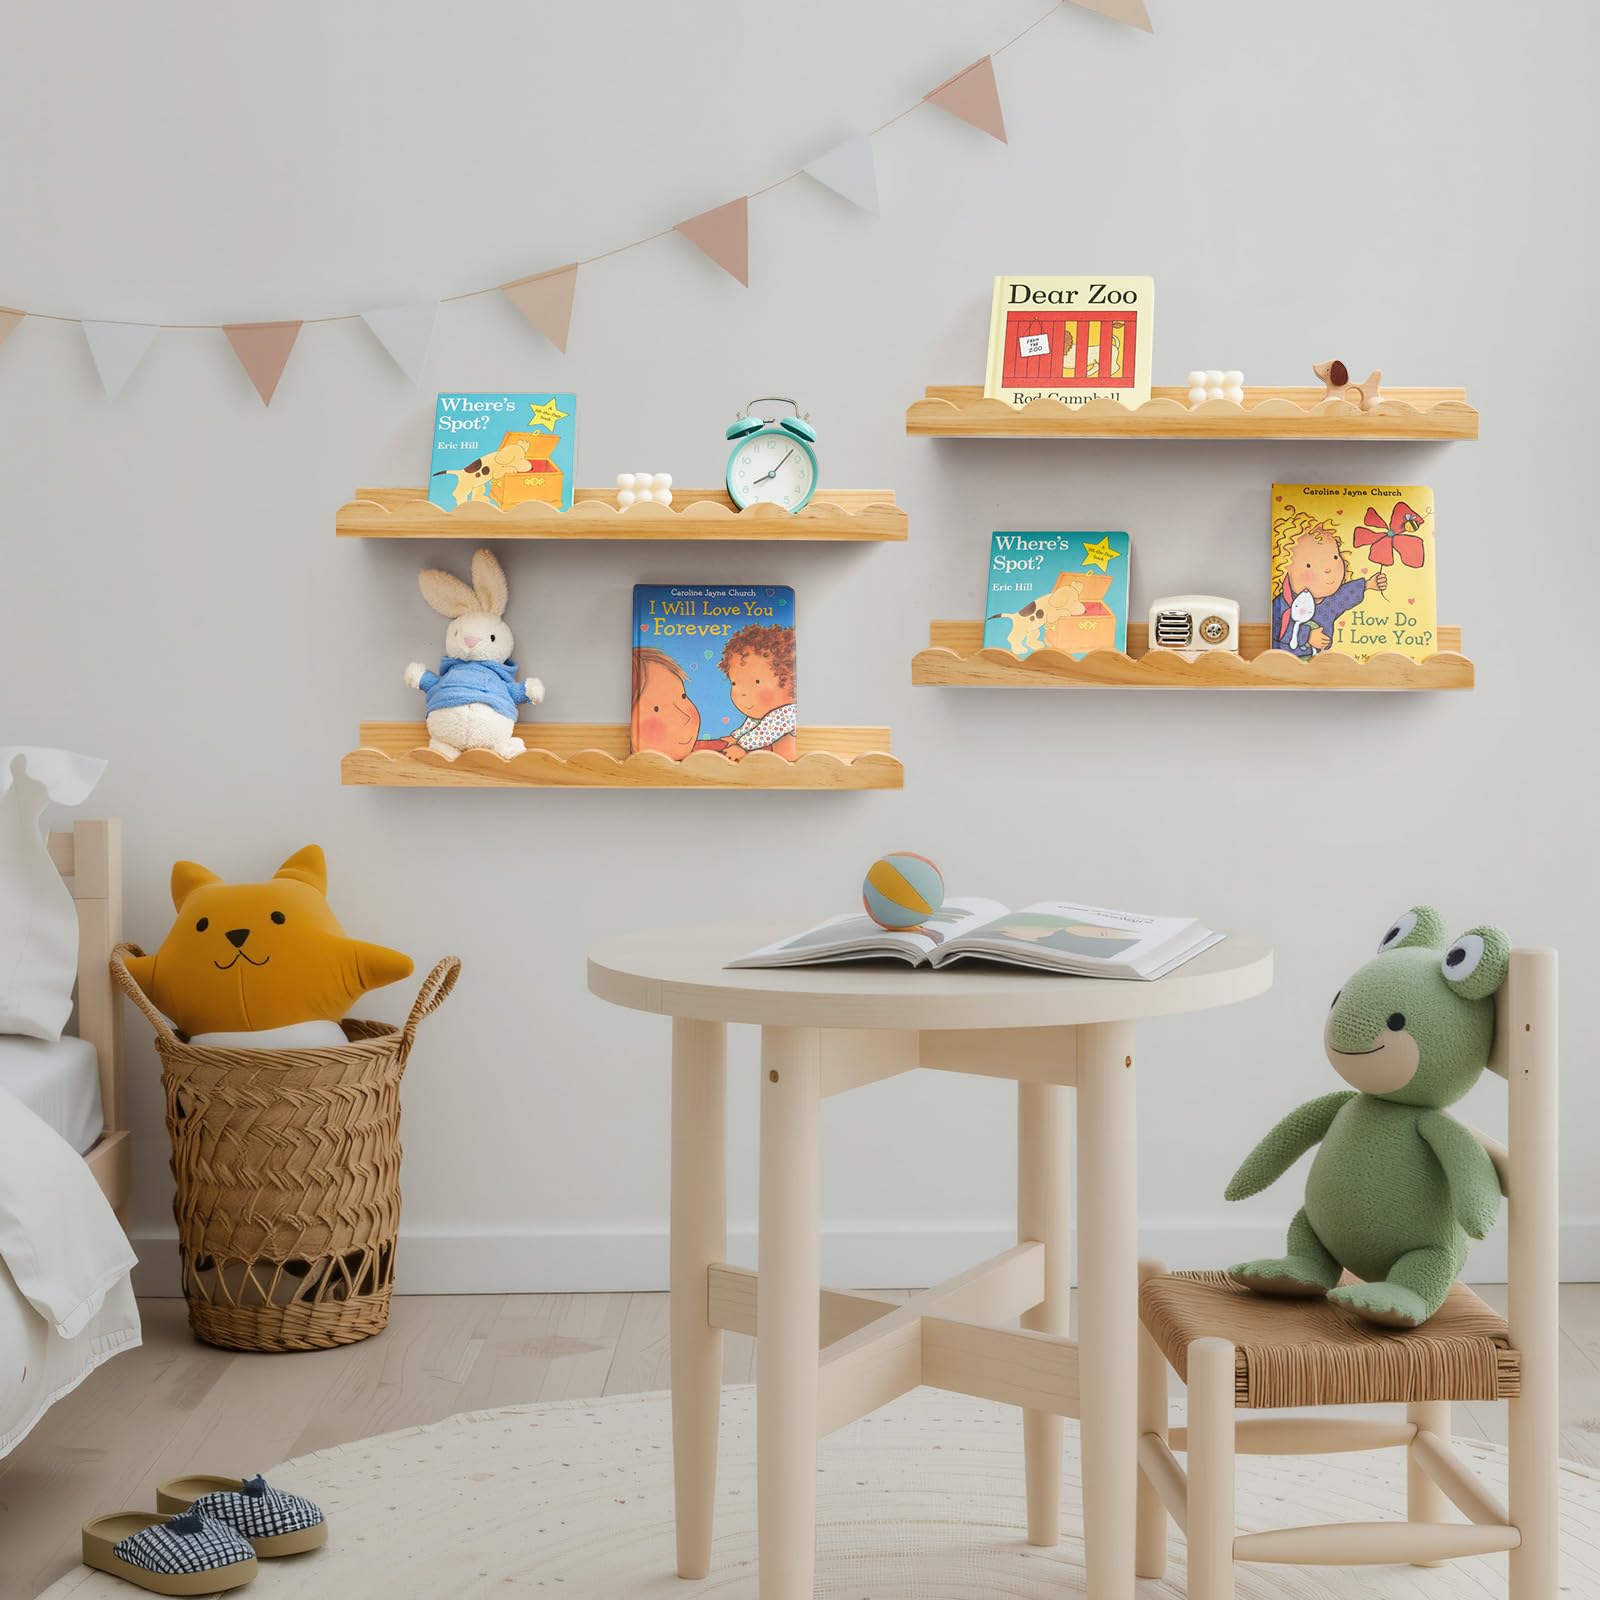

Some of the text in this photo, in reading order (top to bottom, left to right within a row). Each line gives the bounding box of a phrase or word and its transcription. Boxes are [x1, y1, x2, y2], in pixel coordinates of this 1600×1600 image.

[1008, 284, 1138, 304] Dear Zoo
[1028, 345, 1043, 353] ZOO
[441, 397, 516, 412] Where's
[439, 415, 490, 433] Spot?
[437, 441, 479, 450] Eric Hill
[1303, 487, 1402, 497] Caroline Jayne Church
[995, 535, 1069, 551] Where's
[993, 555, 1044, 573] Spot?
[671, 588, 756, 598] Caroline Jayne Church
[992, 583, 1033, 591] Eric Hill
[649, 600, 773, 617] I Will Love You
[653, 617, 732, 636] Forever
[1351, 611, 1417, 627] How Do
[1337, 628, 1433, 646] I Love You?
